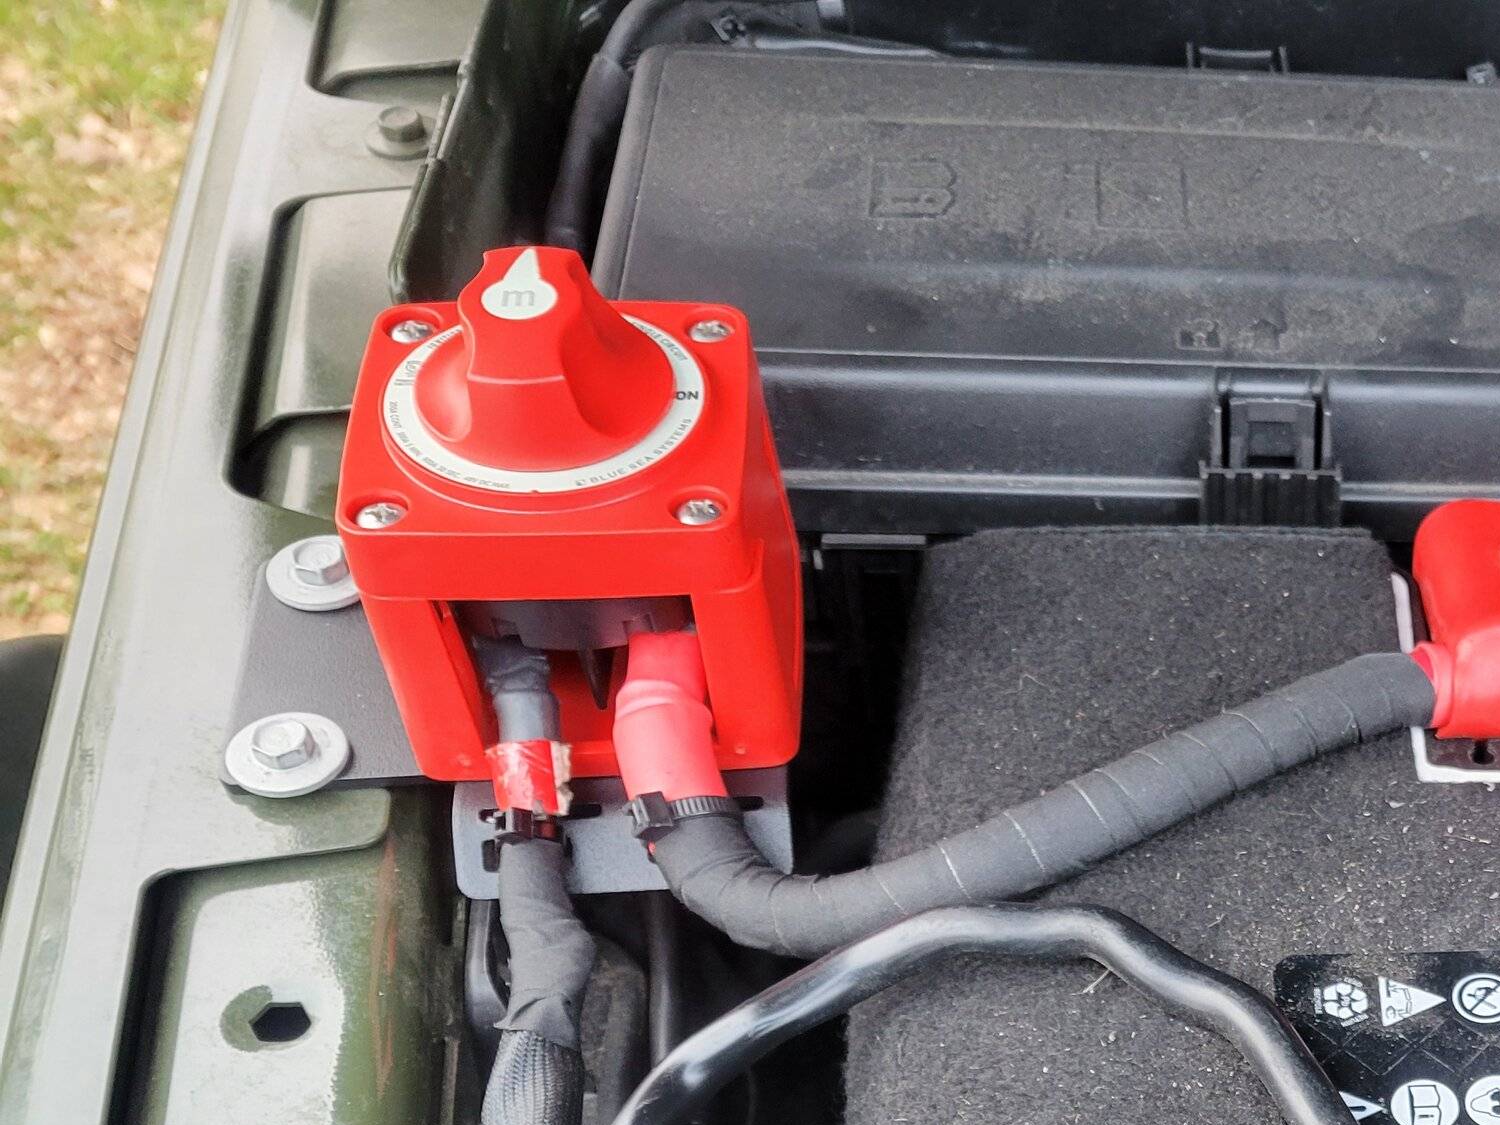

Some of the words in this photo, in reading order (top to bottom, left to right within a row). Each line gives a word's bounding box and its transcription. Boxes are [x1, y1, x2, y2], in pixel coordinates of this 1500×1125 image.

[675, 390, 699, 401] ON
[589, 467, 626, 484] BLUE
[629, 456, 652, 471] SEA
[654, 418, 693, 455] SYSTEMS
